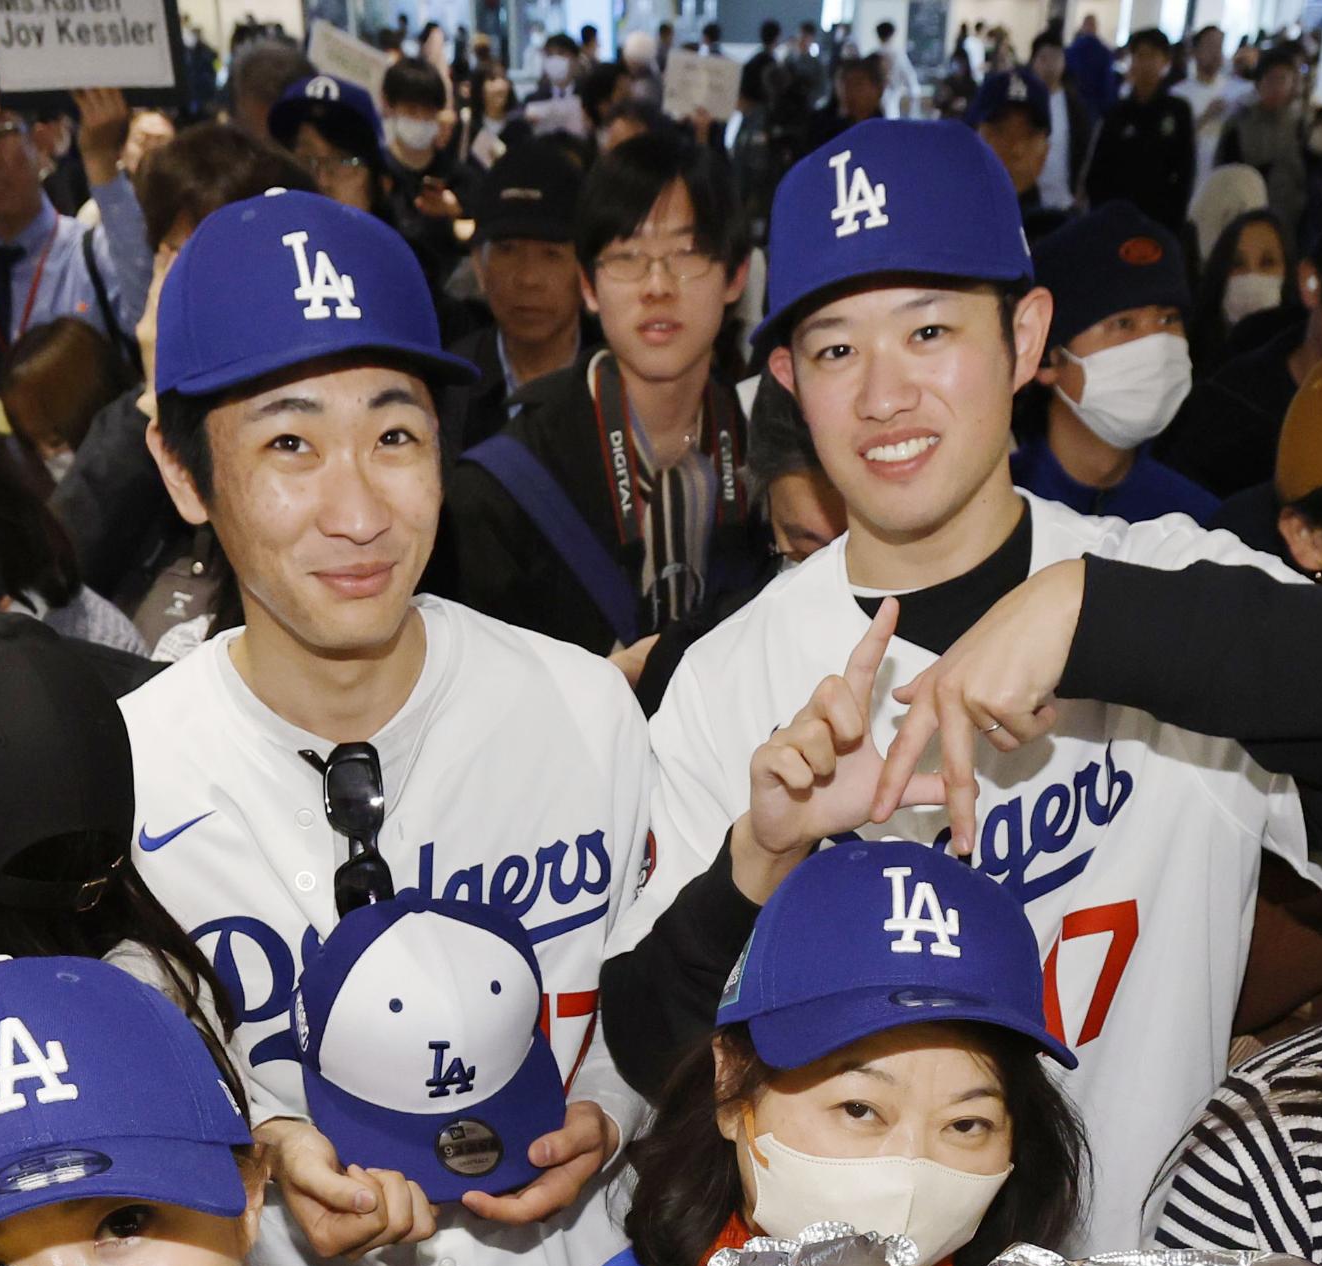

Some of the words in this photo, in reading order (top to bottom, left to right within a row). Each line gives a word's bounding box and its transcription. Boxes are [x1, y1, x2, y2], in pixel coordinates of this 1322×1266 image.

[1, 19, 44, 48] Joy
[56, 17, 155, 47] Kessler
[829, 150, 889, 237] LA
[282, 231, 362, 320] LA
[609, 430, 633, 516] DIGITAL
[883, 866, 961, 958] LA
[429, 1041, 476, 1098] LA
